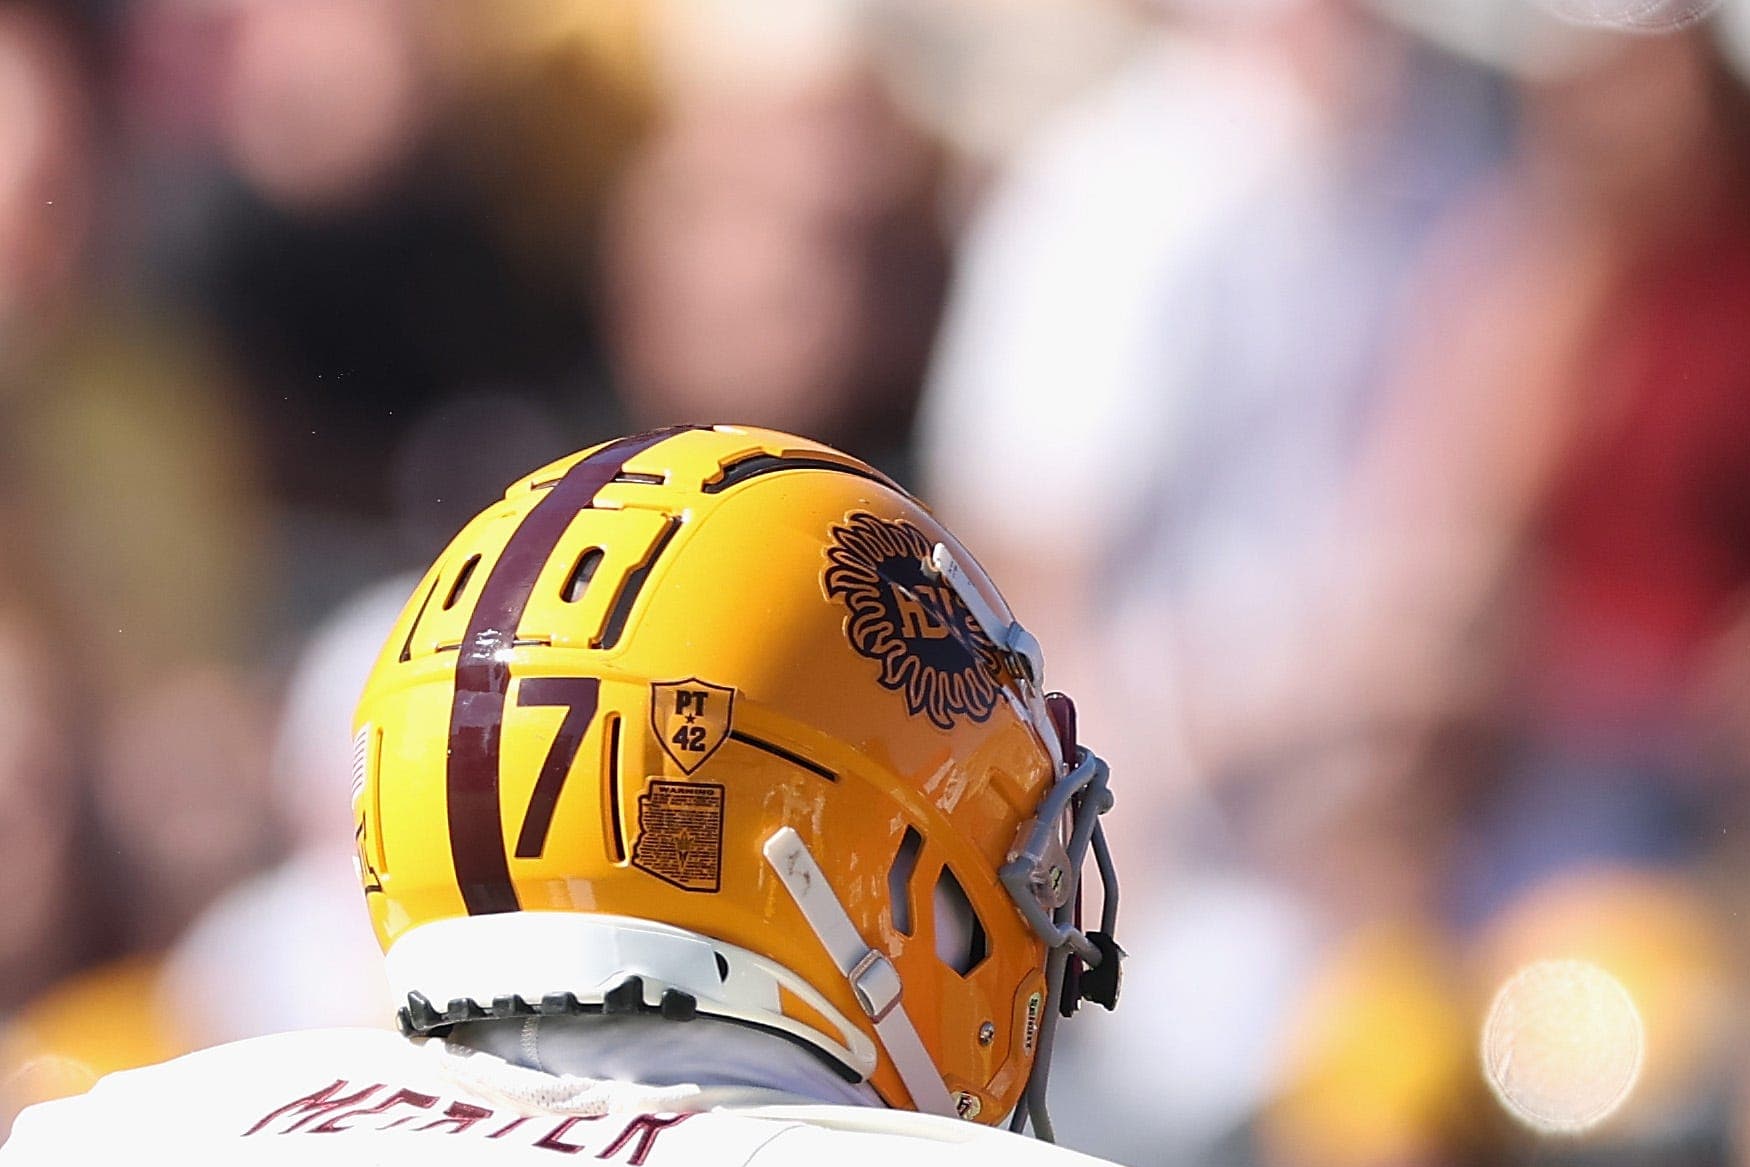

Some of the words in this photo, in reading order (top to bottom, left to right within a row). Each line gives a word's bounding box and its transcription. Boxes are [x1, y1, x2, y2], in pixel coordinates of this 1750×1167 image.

[675, 690, 708, 716] PT
[672, 726, 706, 752] 42
[512, 677, 599, 859] 7
